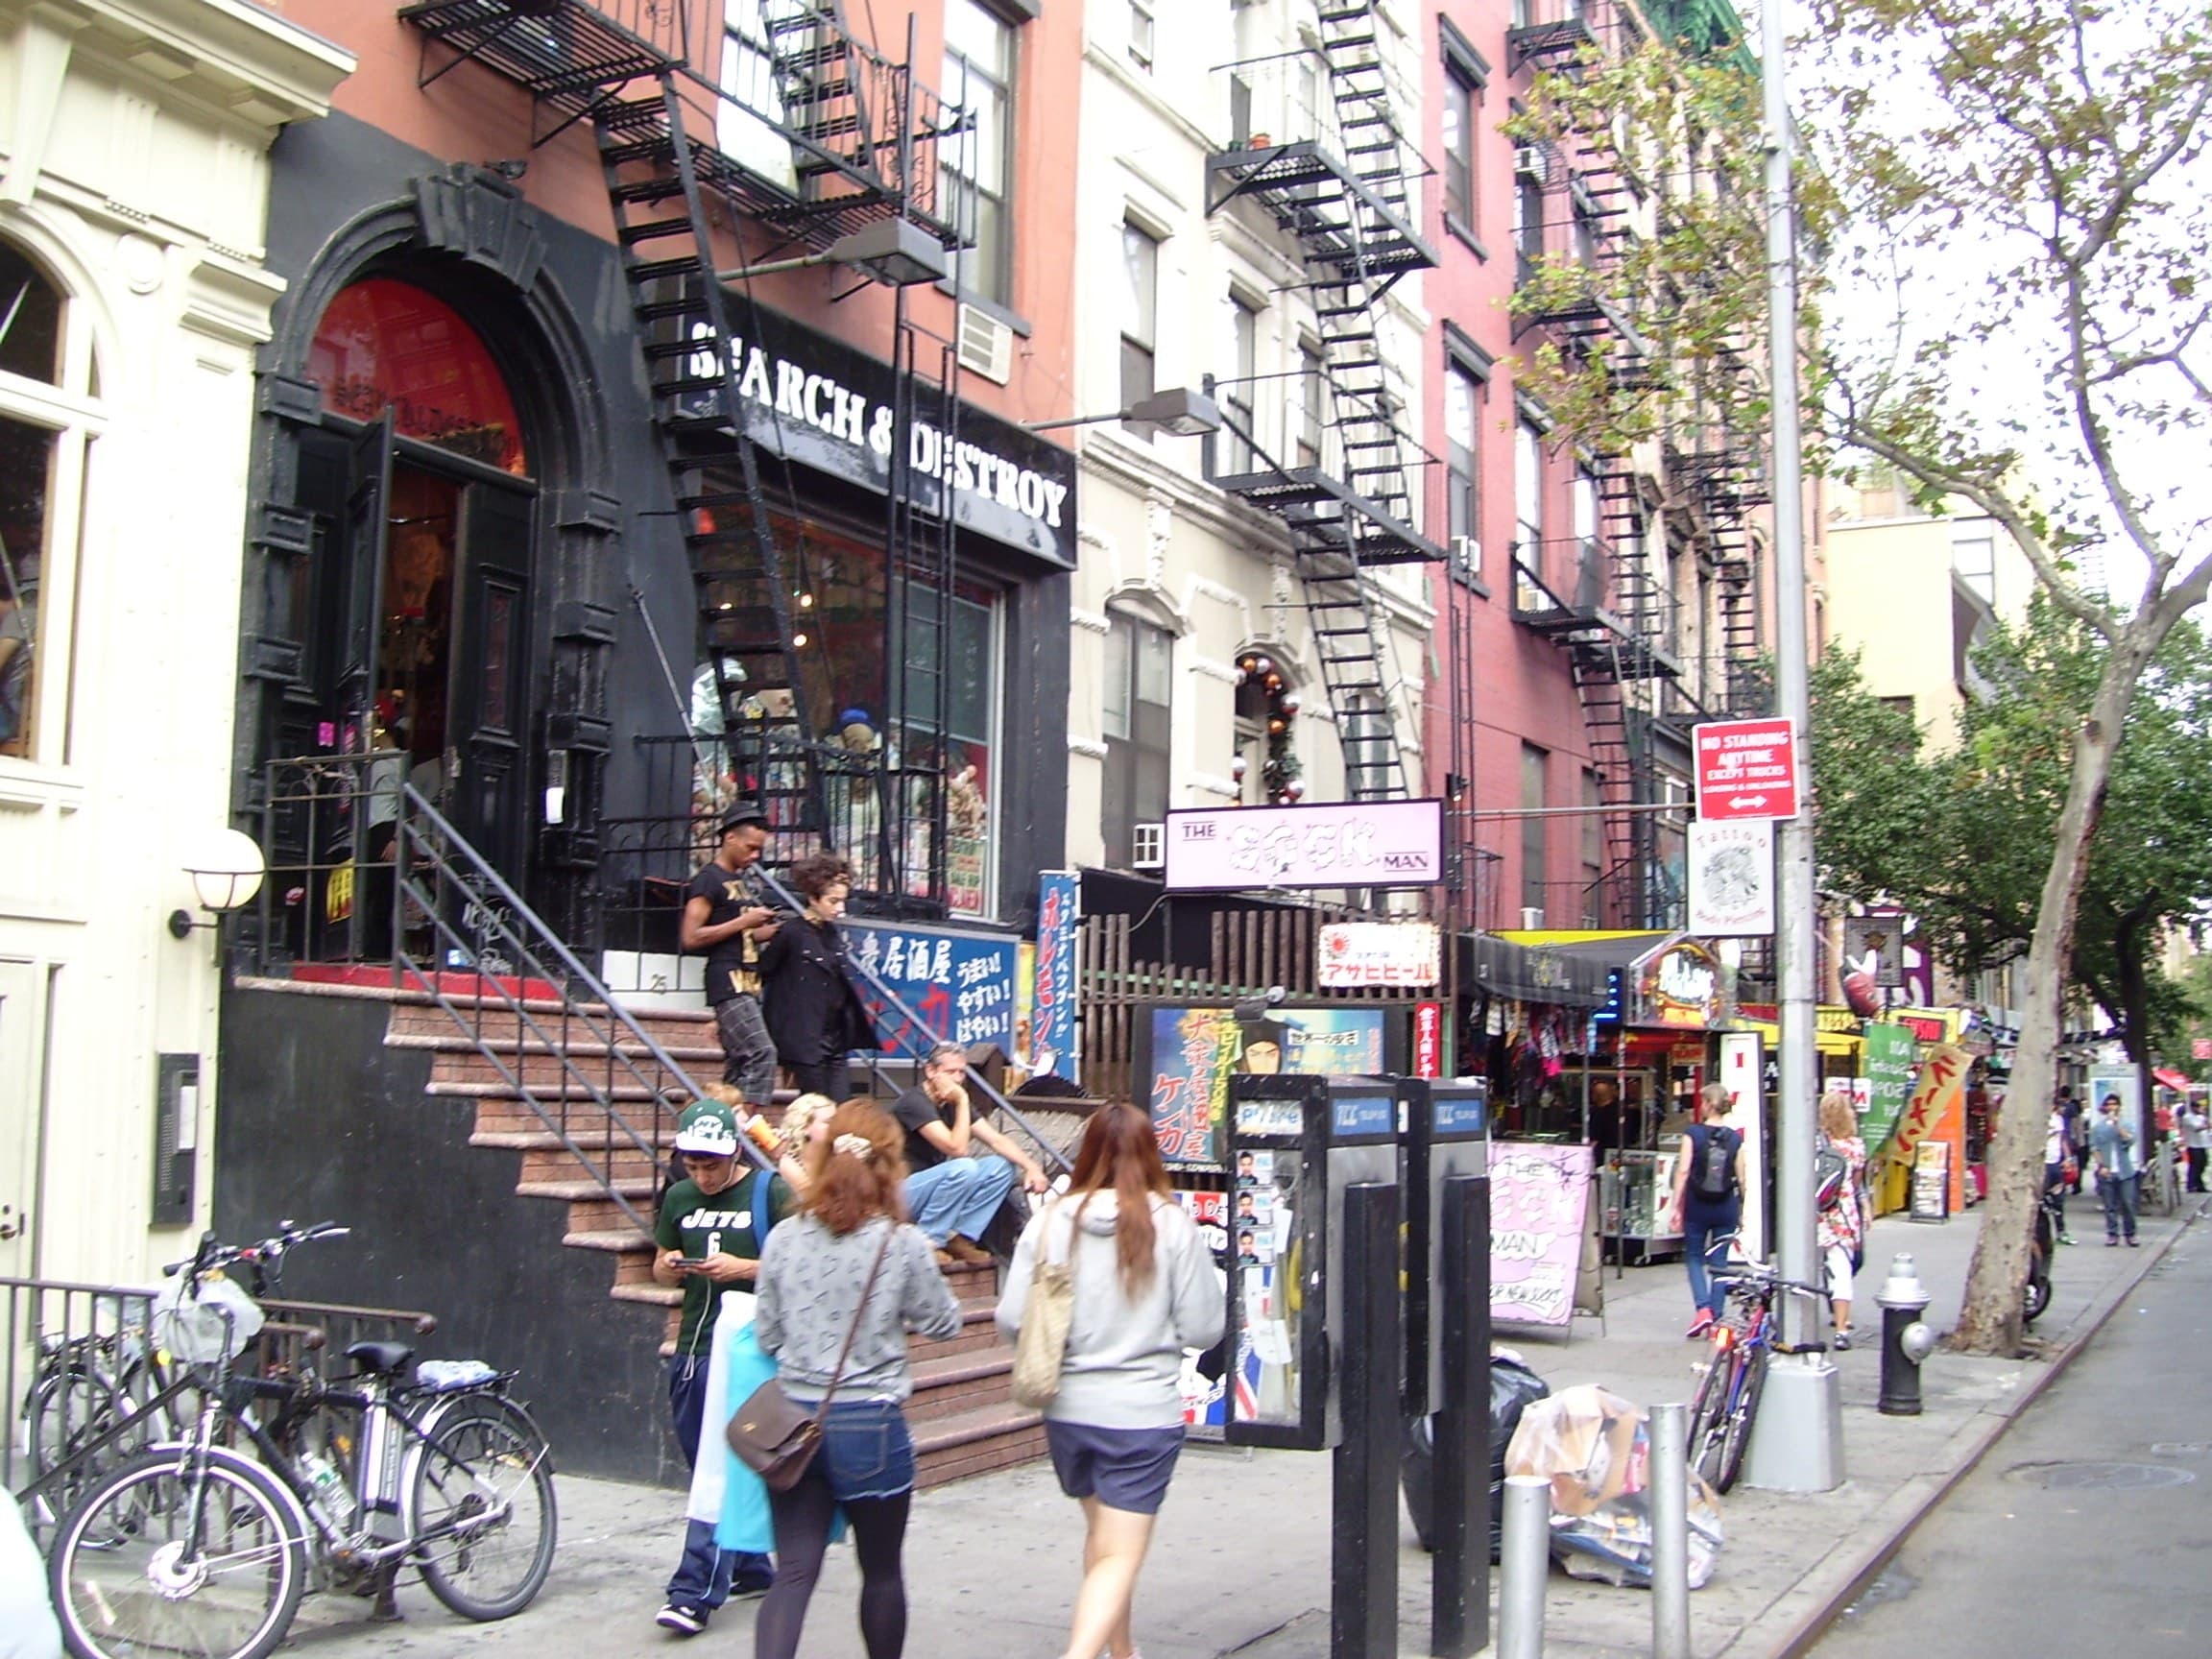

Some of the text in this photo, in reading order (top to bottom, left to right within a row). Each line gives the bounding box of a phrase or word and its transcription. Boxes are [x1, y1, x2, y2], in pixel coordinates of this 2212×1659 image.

[869, 405, 893, 456] &
[911, 421, 1067, 528] DESTROY
[1701, 732, 1790, 751] NO STANDING
[1717, 749, 1774, 766] ANYTIME
[1183, 824, 1216, 838] THE
[1384, 854, 1429, 869] MAN
[1504, 1163, 1545, 1177] THE
[682, 1208, 752, 1229] JETS
[708, 1232, 722, 1257] 6
